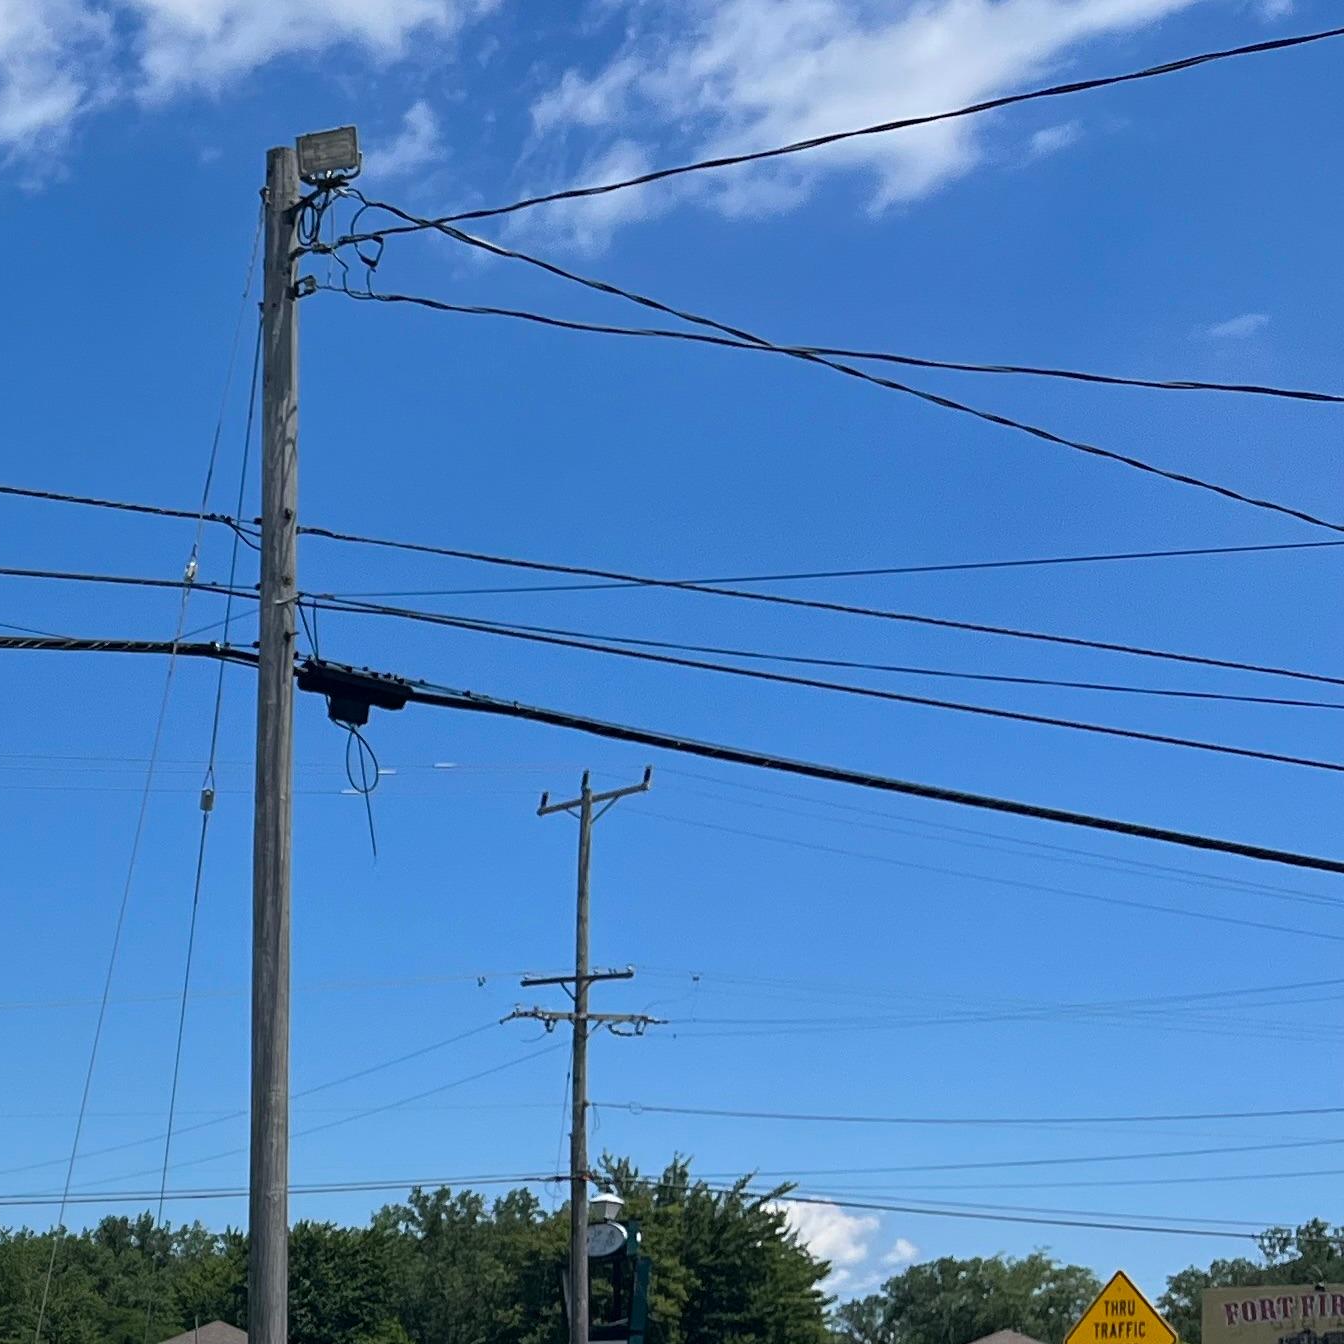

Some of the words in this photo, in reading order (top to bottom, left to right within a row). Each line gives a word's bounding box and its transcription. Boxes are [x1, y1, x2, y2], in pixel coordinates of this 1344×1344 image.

[1104, 1300, 1135, 1316] THRU
[1224, 1296, 1293, 1327] FORT
[1094, 1321, 1146, 1339] TRAFFIC
